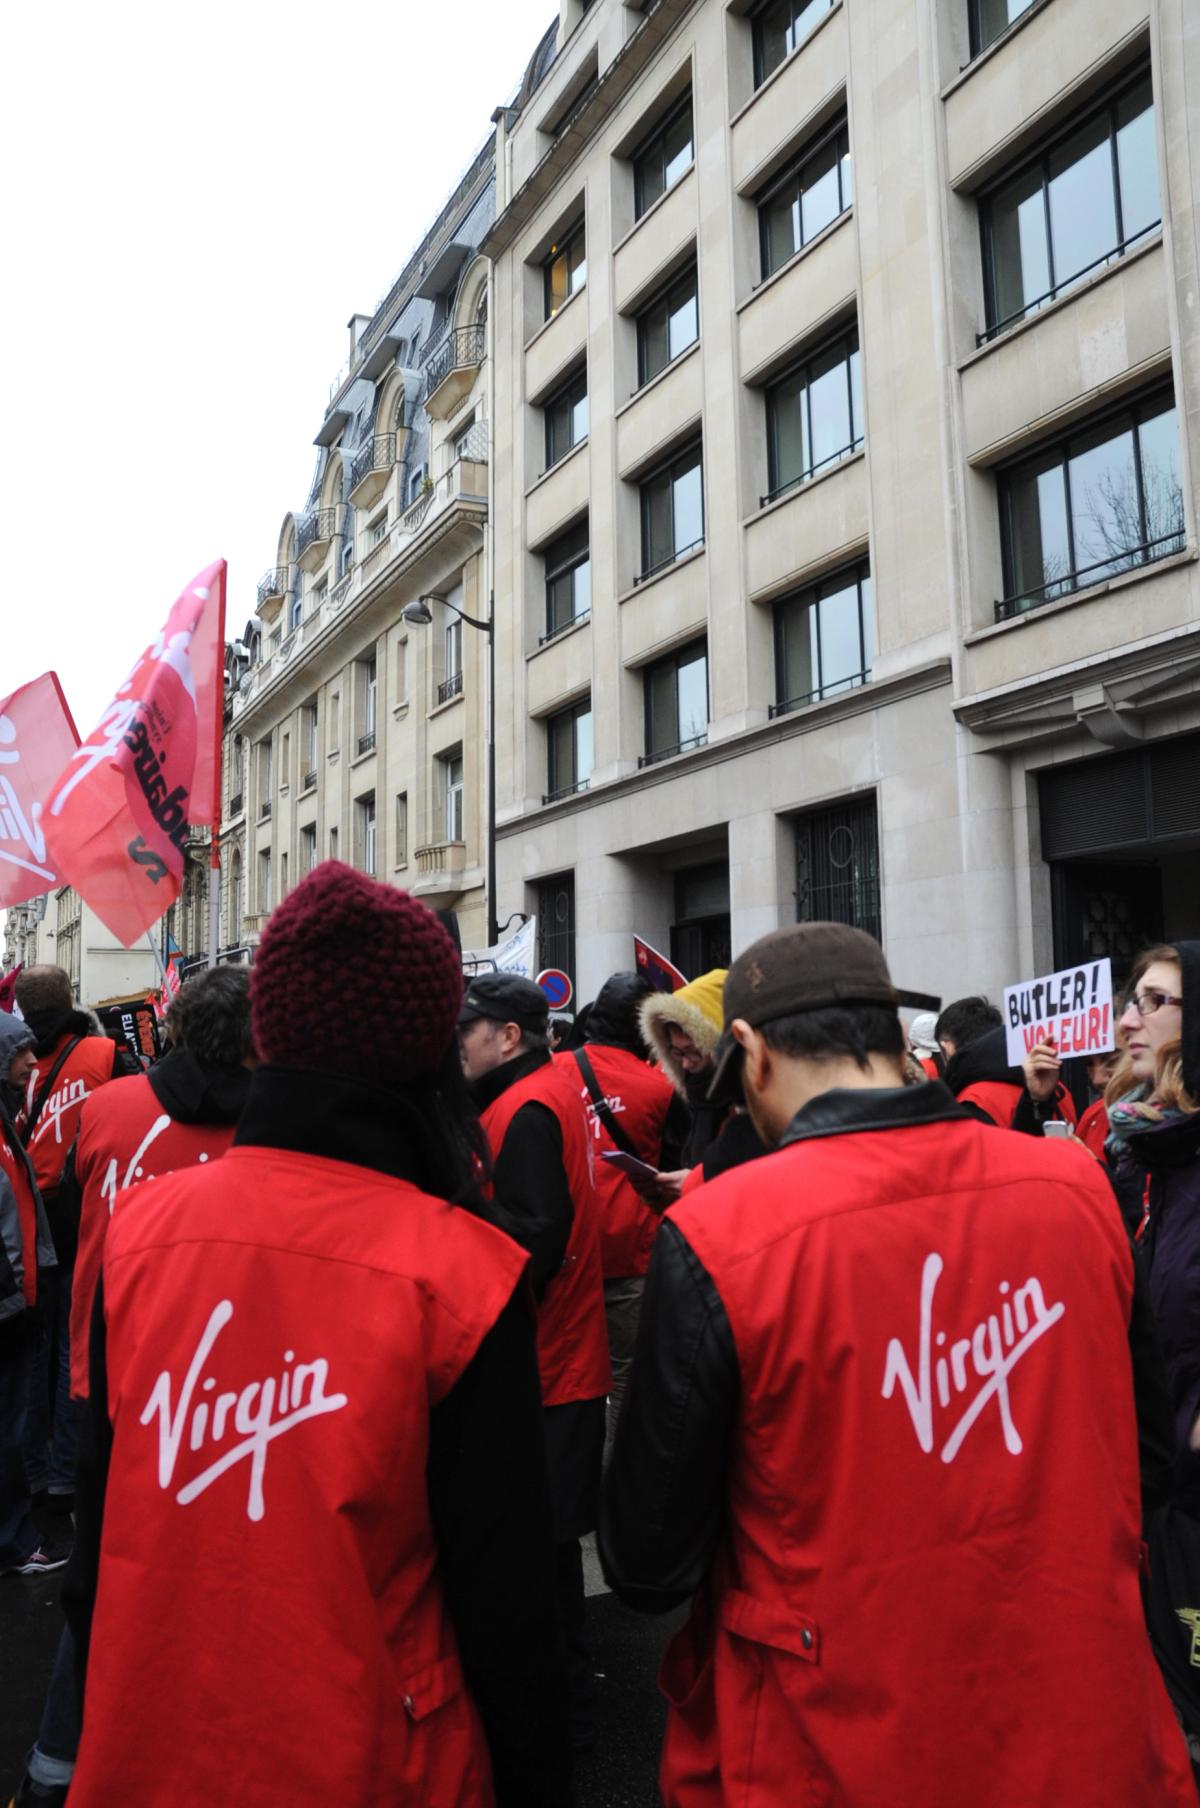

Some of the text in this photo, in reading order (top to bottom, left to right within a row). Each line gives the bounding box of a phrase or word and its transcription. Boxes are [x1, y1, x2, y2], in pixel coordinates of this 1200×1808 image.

[1009, 965, 1099, 1029] BUTLER!
[139, 1299, 348, 1522] Virgin
[880, 1252, 1065, 1464] Virgin
